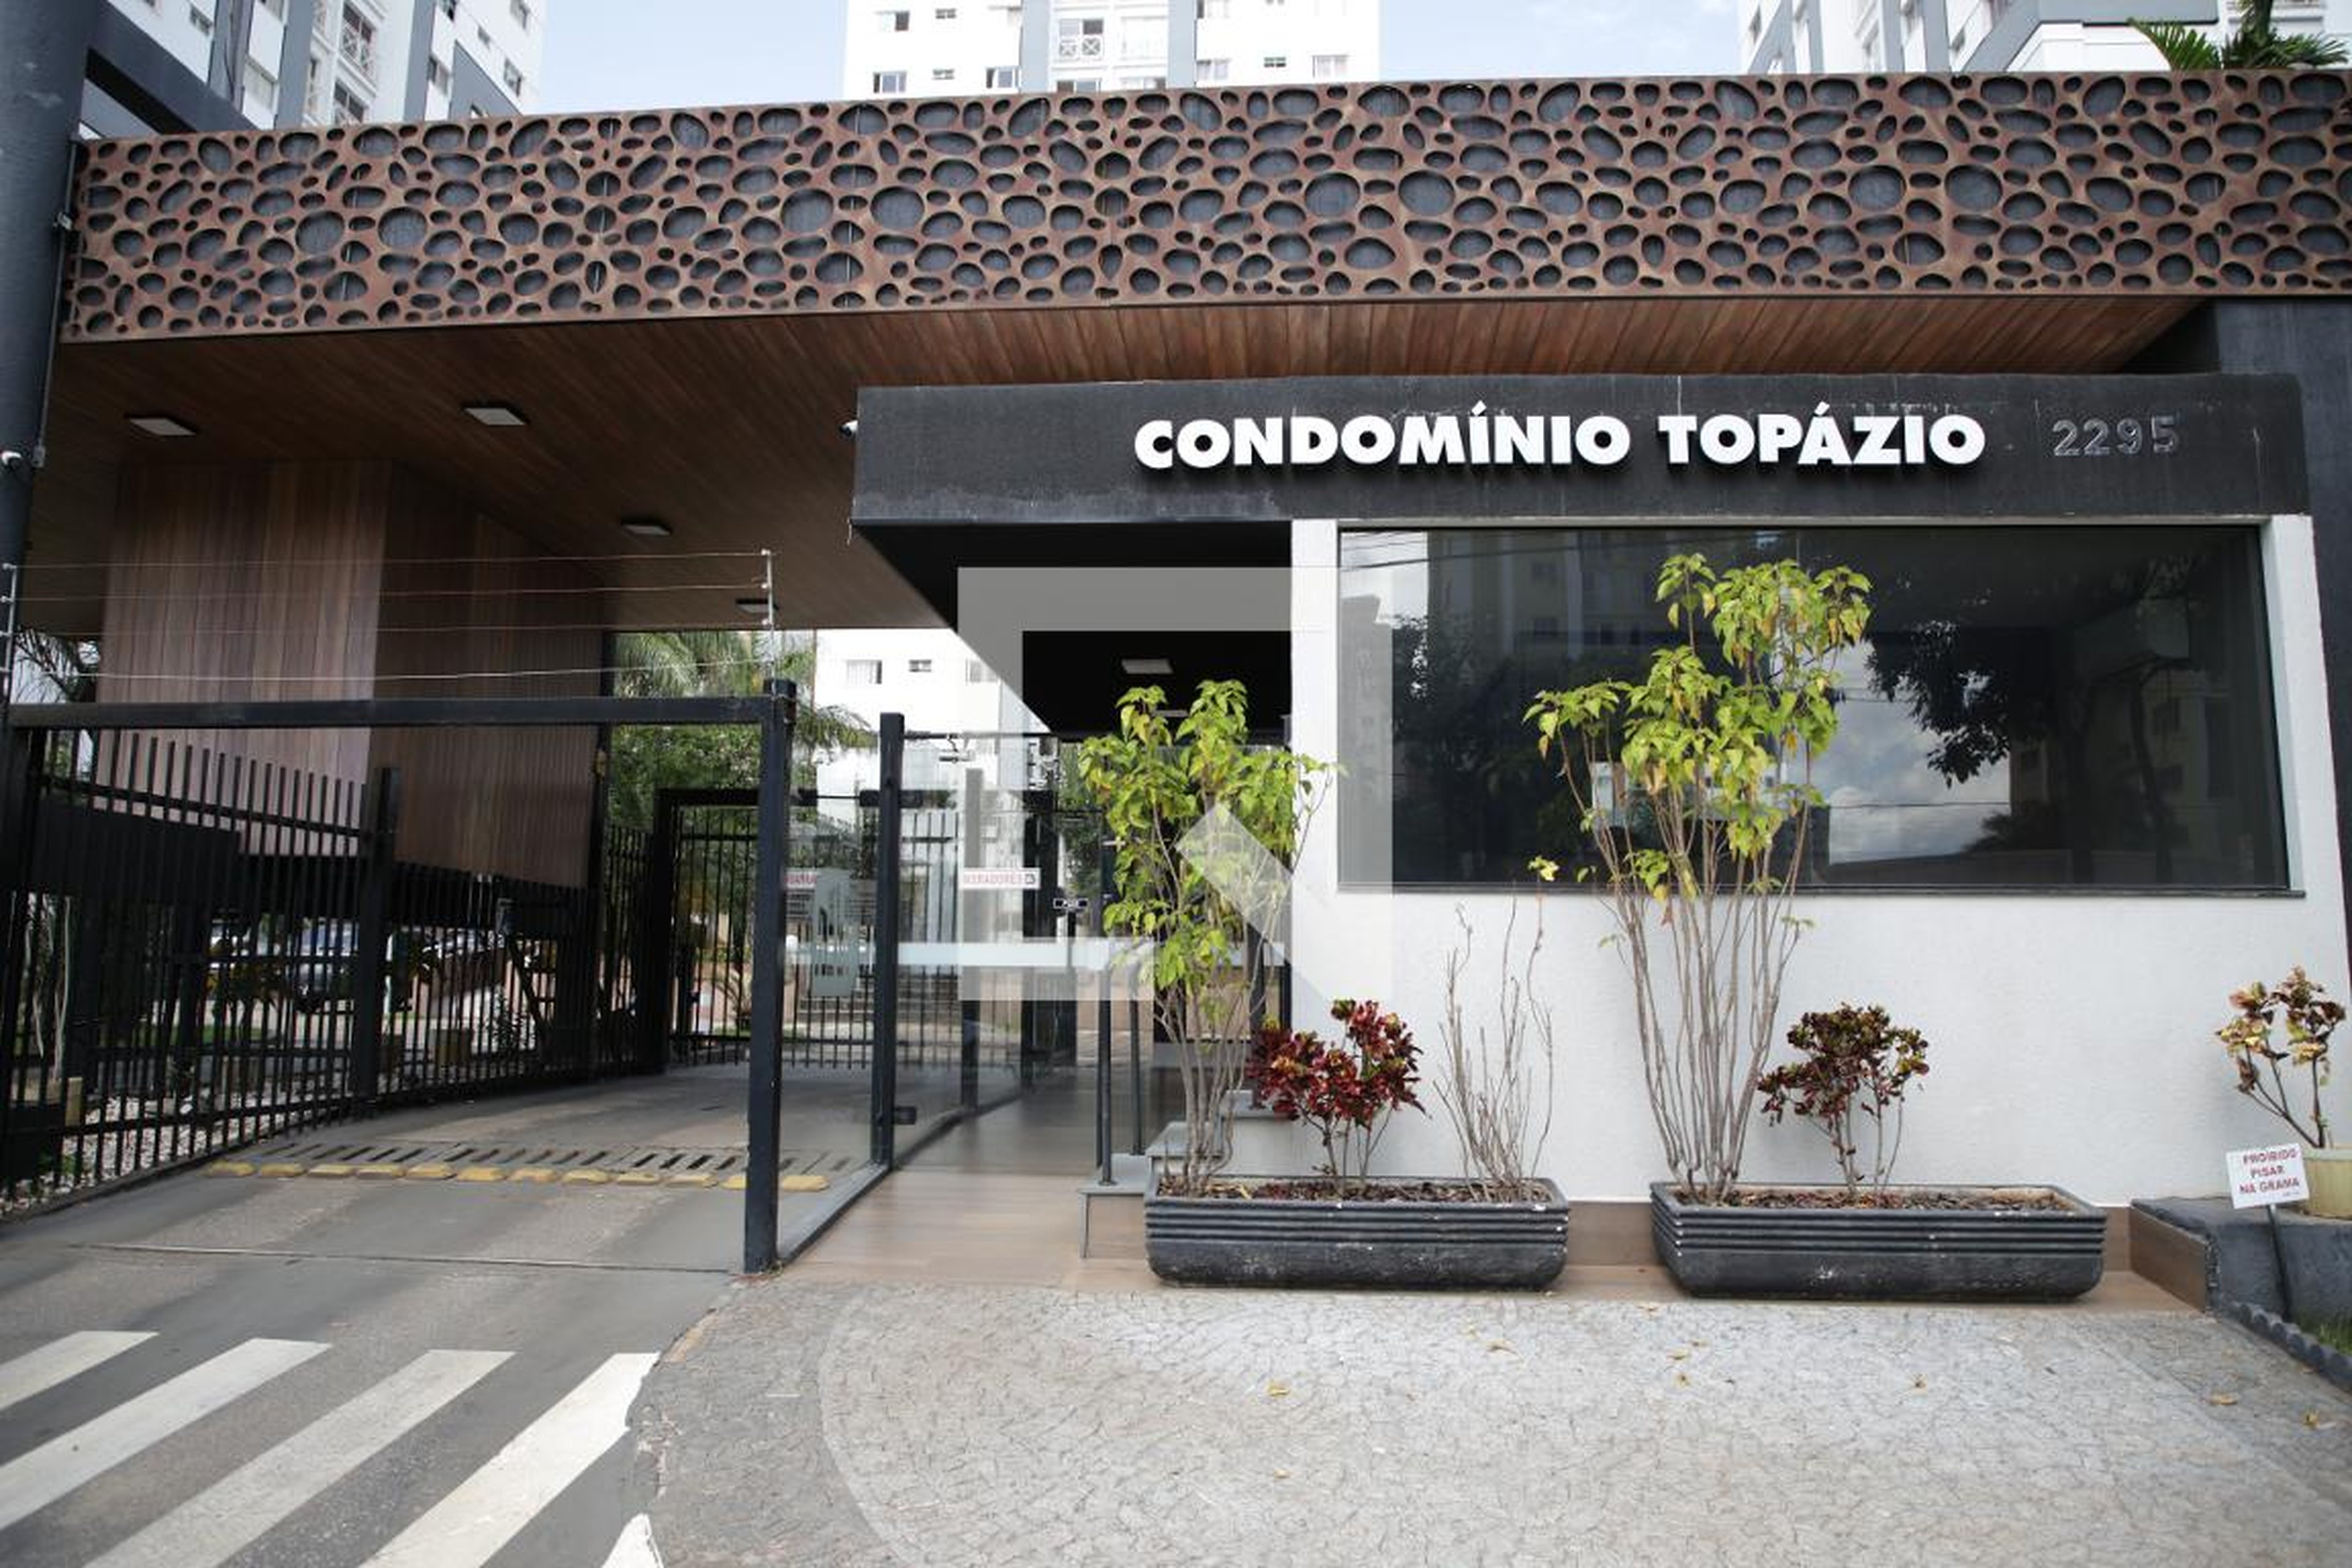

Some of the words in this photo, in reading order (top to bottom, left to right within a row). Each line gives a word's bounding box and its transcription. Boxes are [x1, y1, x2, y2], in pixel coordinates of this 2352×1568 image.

[1135, 401, 1630, 469] CONDOMÍNIO
[1659, 402, 1985, 464] TOPÁZIO
[2052, 417, 2179, 456] 2295
[2251, 1165, 2285, 1179] PISAR
[2239, 1183, 2256, 1194] NA
[2259, 1178, 2299, 1193] GRAMA
